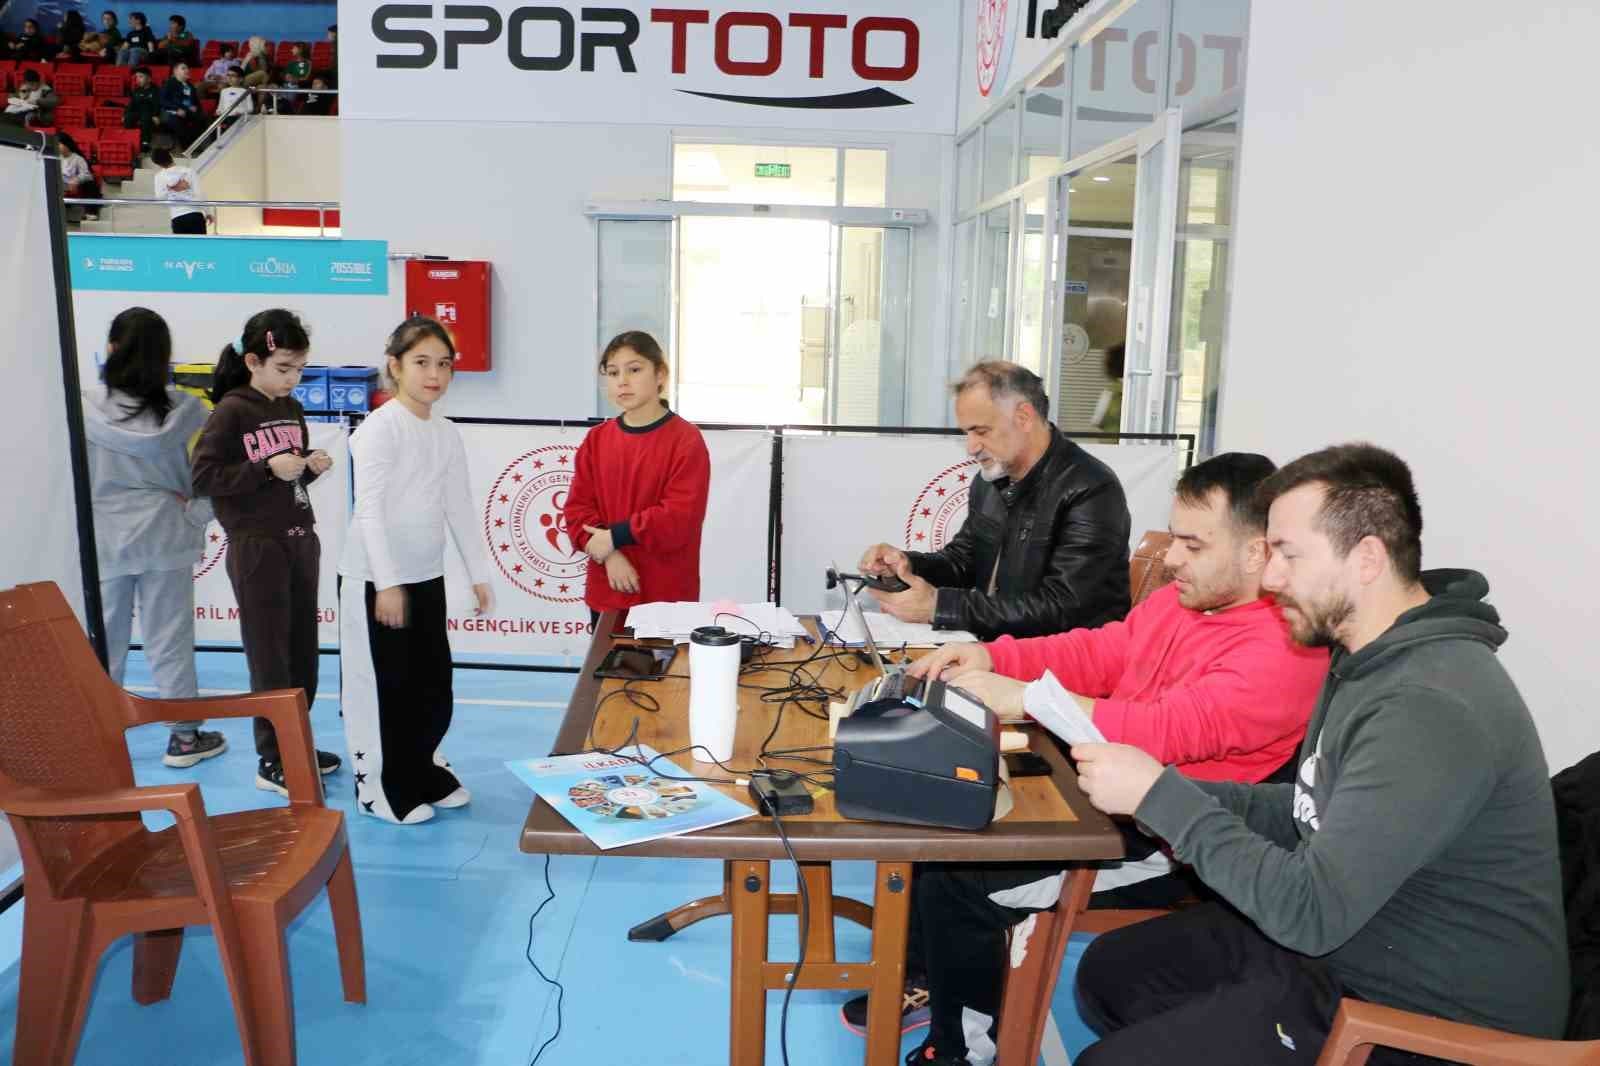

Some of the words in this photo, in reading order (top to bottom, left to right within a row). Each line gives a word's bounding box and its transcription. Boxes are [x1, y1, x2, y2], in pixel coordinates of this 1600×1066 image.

[462, 617, 536, 636] GENÇLİK
[539, 621, 561, 634] VE
[564, 622, 594, 635] SPO
